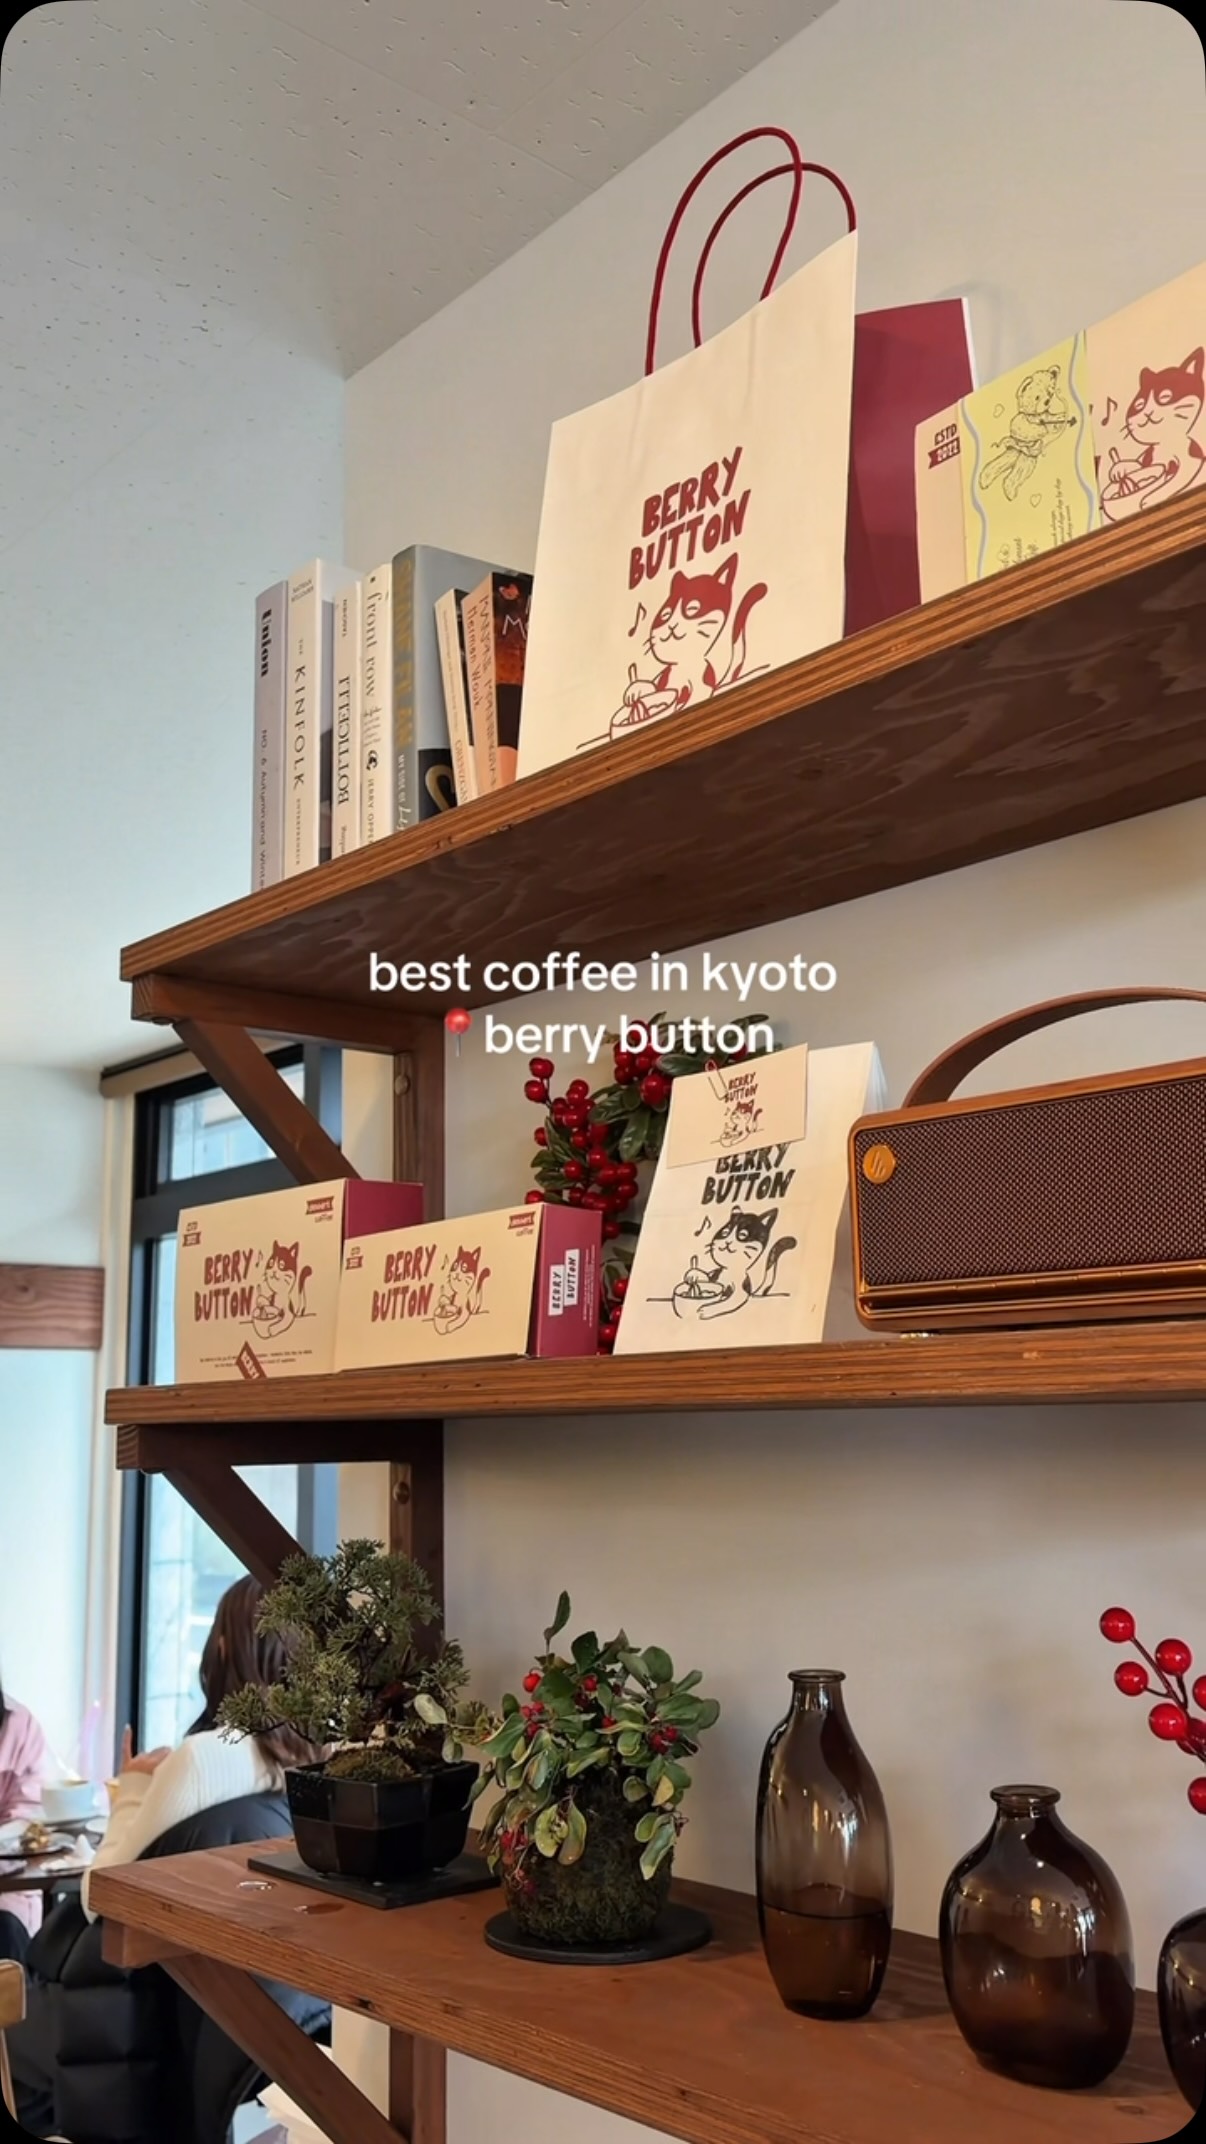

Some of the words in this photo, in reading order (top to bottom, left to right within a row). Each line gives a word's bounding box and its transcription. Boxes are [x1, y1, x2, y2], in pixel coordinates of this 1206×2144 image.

[642, 446, 743, 538] BERRY
[629, 488, 752, 590] BUTTON
[366, 592, 382, 648] front
[467, 605, 478, 663] Herman
[261, 608, 272, 677] Union
[366, 657, 376, 697] row
[472, 663, 483, 710] Wouk
[294, 664, 306, 790] KINFOLK
[338, 676, 350, 805] BOTTICELLI
[259, 771, 268, 817] Autumn
[259, 818, 267, 845] and
[724, 1083, 758, 1103] BUTTON
[728, 1071, 756, 1091] BERRY
[701, 1168, 796, 1206] BUTTON
[204, 1248, 254, 1286] BERRY
[384, 1243, 437, 1284] BERRY
[566, 1256, 577, 1299] BUTTON
[194, 1285, 254, 1322] BUTTON
[371, 1282, 435, 1323] BUTTON
[552, 1270, 562, 1309] BERRY
